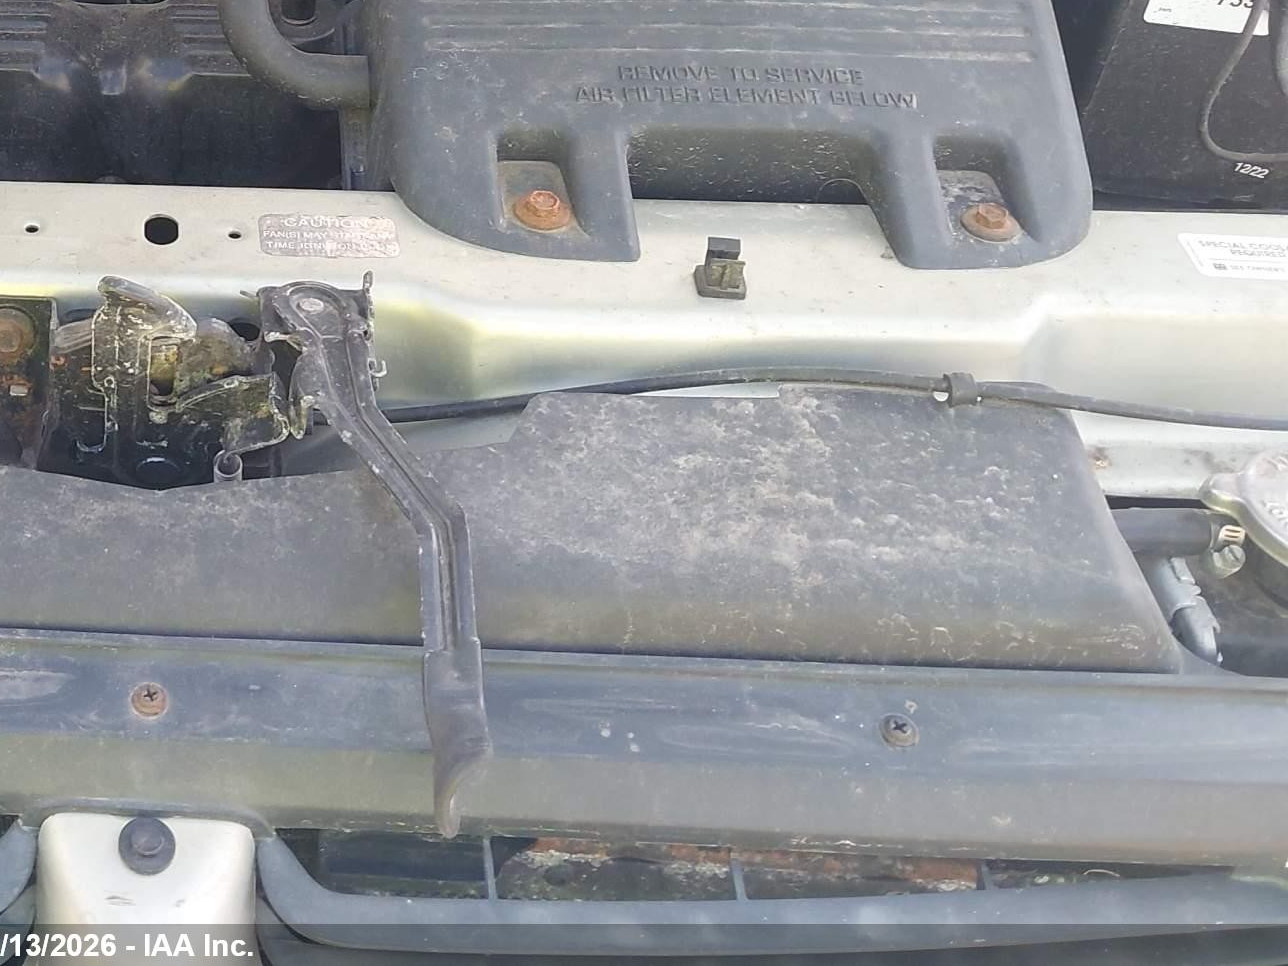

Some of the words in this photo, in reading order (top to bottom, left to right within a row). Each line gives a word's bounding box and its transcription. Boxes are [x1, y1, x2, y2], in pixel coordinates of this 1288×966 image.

[616, 65, 719, 84] REMOVE
[729, 67, 760, 83] TO
[765, 67, 864, 86] SERVICE
[575, 87, 615, 103] AIR
[621, 87, 702, 104] FILTER
[711, 87, 821, 105] ELEMENT
[830, 90, 917, 109] BELOW
[1234, 162, 1270, 179] 12/22
[283, 217, 368, 228] CAUTION
[263, 230, 300, 239] FAN(S)
[303, 231, 327, 240] MAY
[266, 241, 296, 250] TIME
